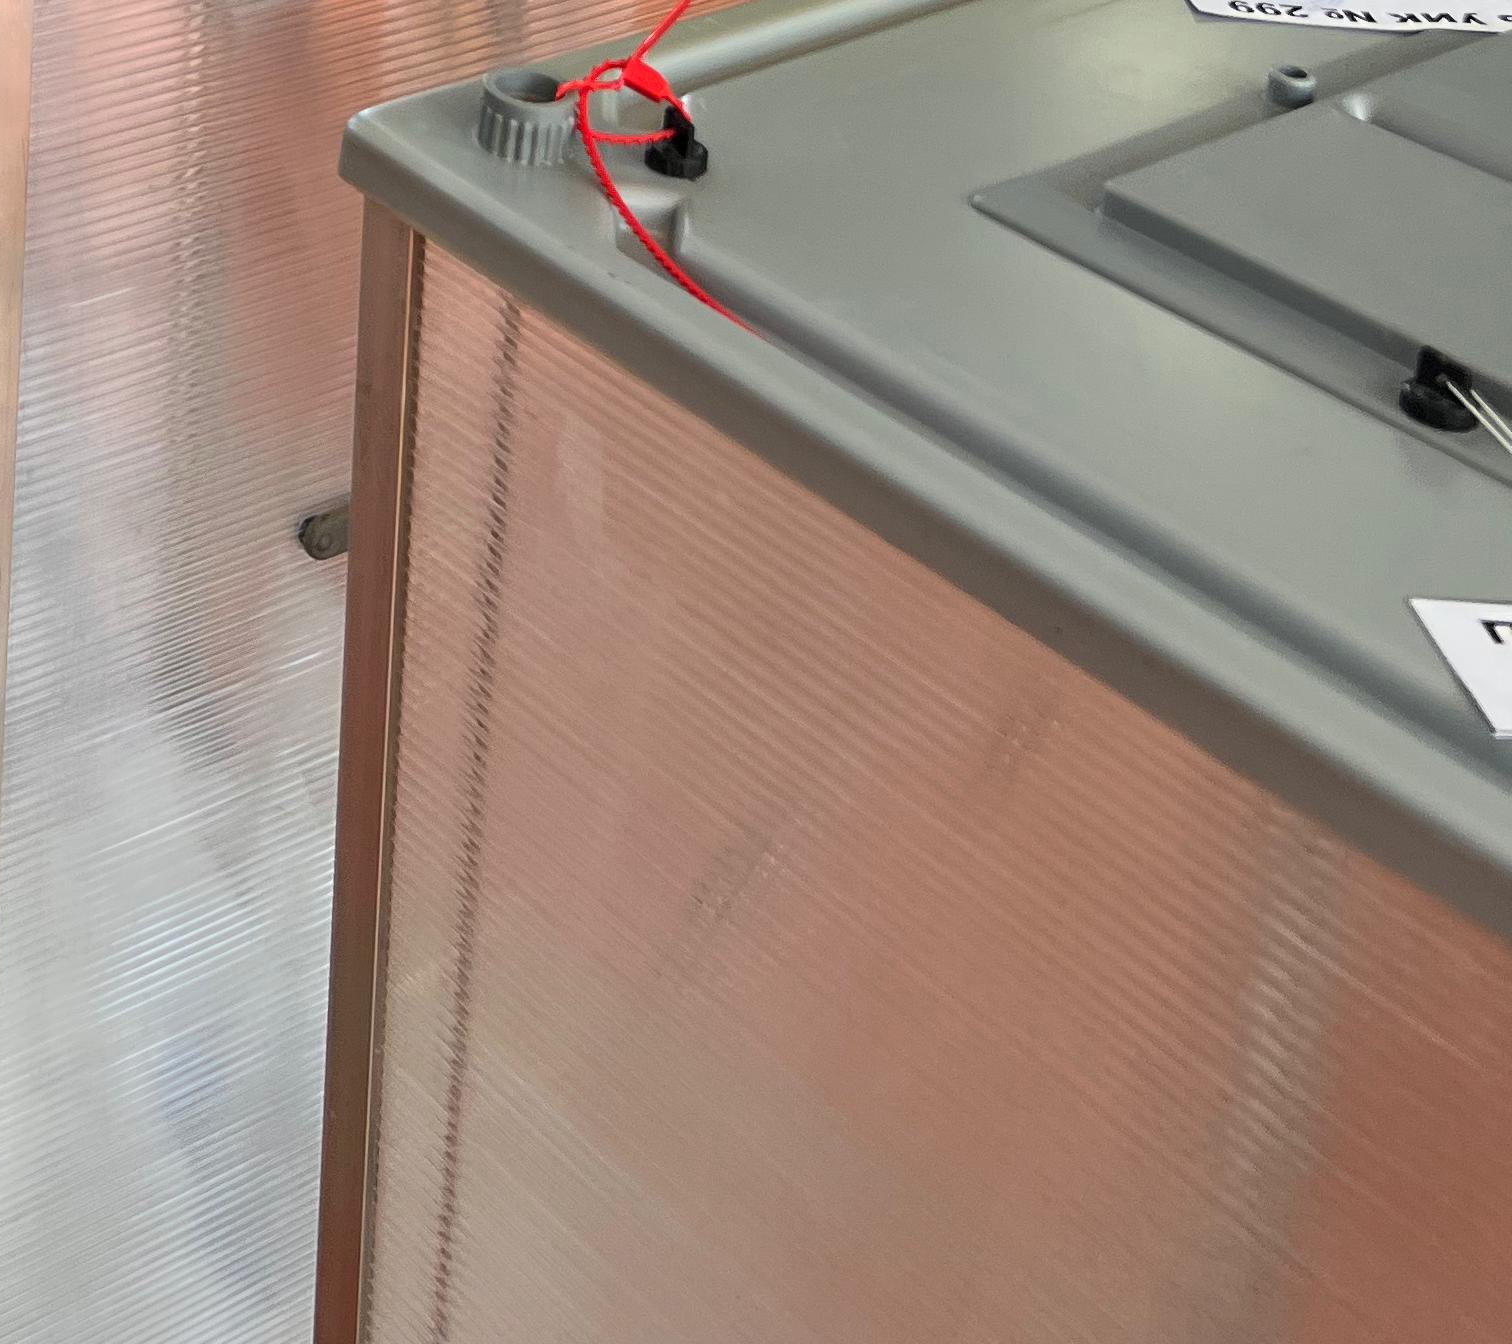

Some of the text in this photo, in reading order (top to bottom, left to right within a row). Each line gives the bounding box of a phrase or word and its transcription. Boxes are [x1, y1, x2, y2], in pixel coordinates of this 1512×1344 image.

[1227, 0, 1309, 18] 299
[1322, 7, 1378, 23] №
[1390, 12, 1487, 26] УИК
